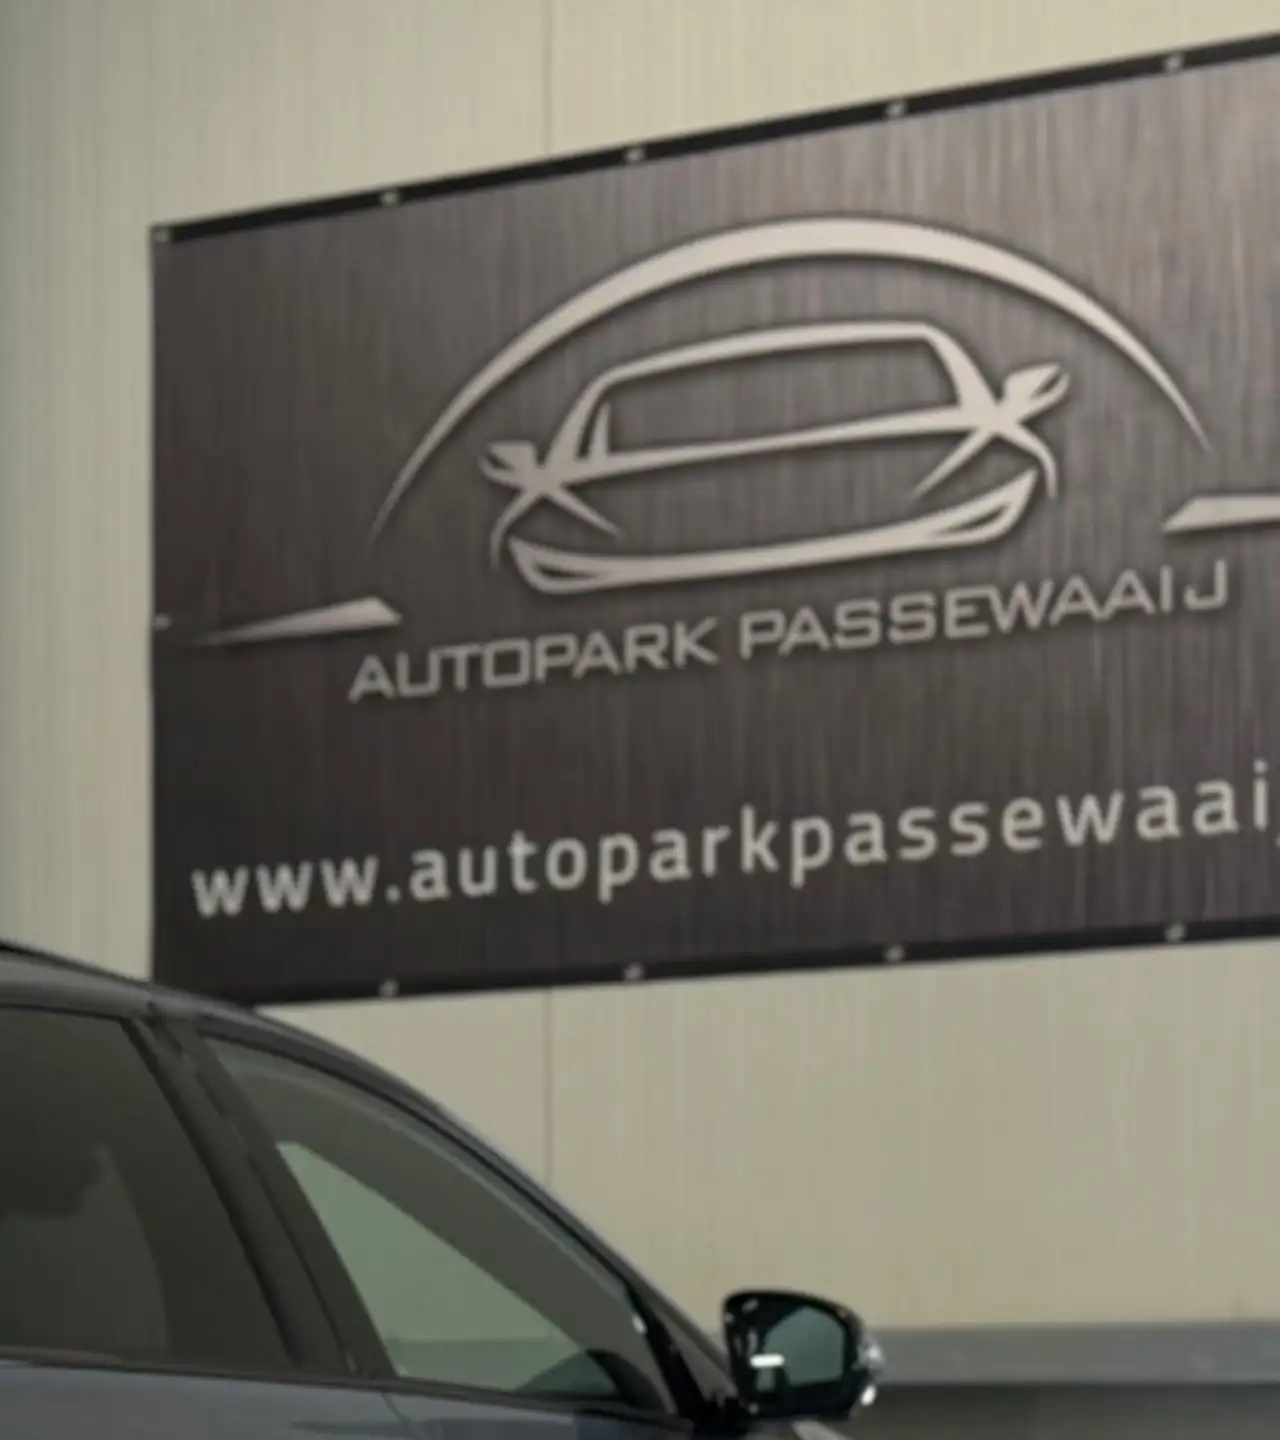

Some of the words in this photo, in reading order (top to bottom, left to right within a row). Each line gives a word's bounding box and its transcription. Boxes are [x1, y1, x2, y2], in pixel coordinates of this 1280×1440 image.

[348, 616, 720, 703] AUTOPARK
[739, 560, 1229, 659] PASSEWAAIJ
[191, 759, 1280, 917] www.autoparkpassewaai
